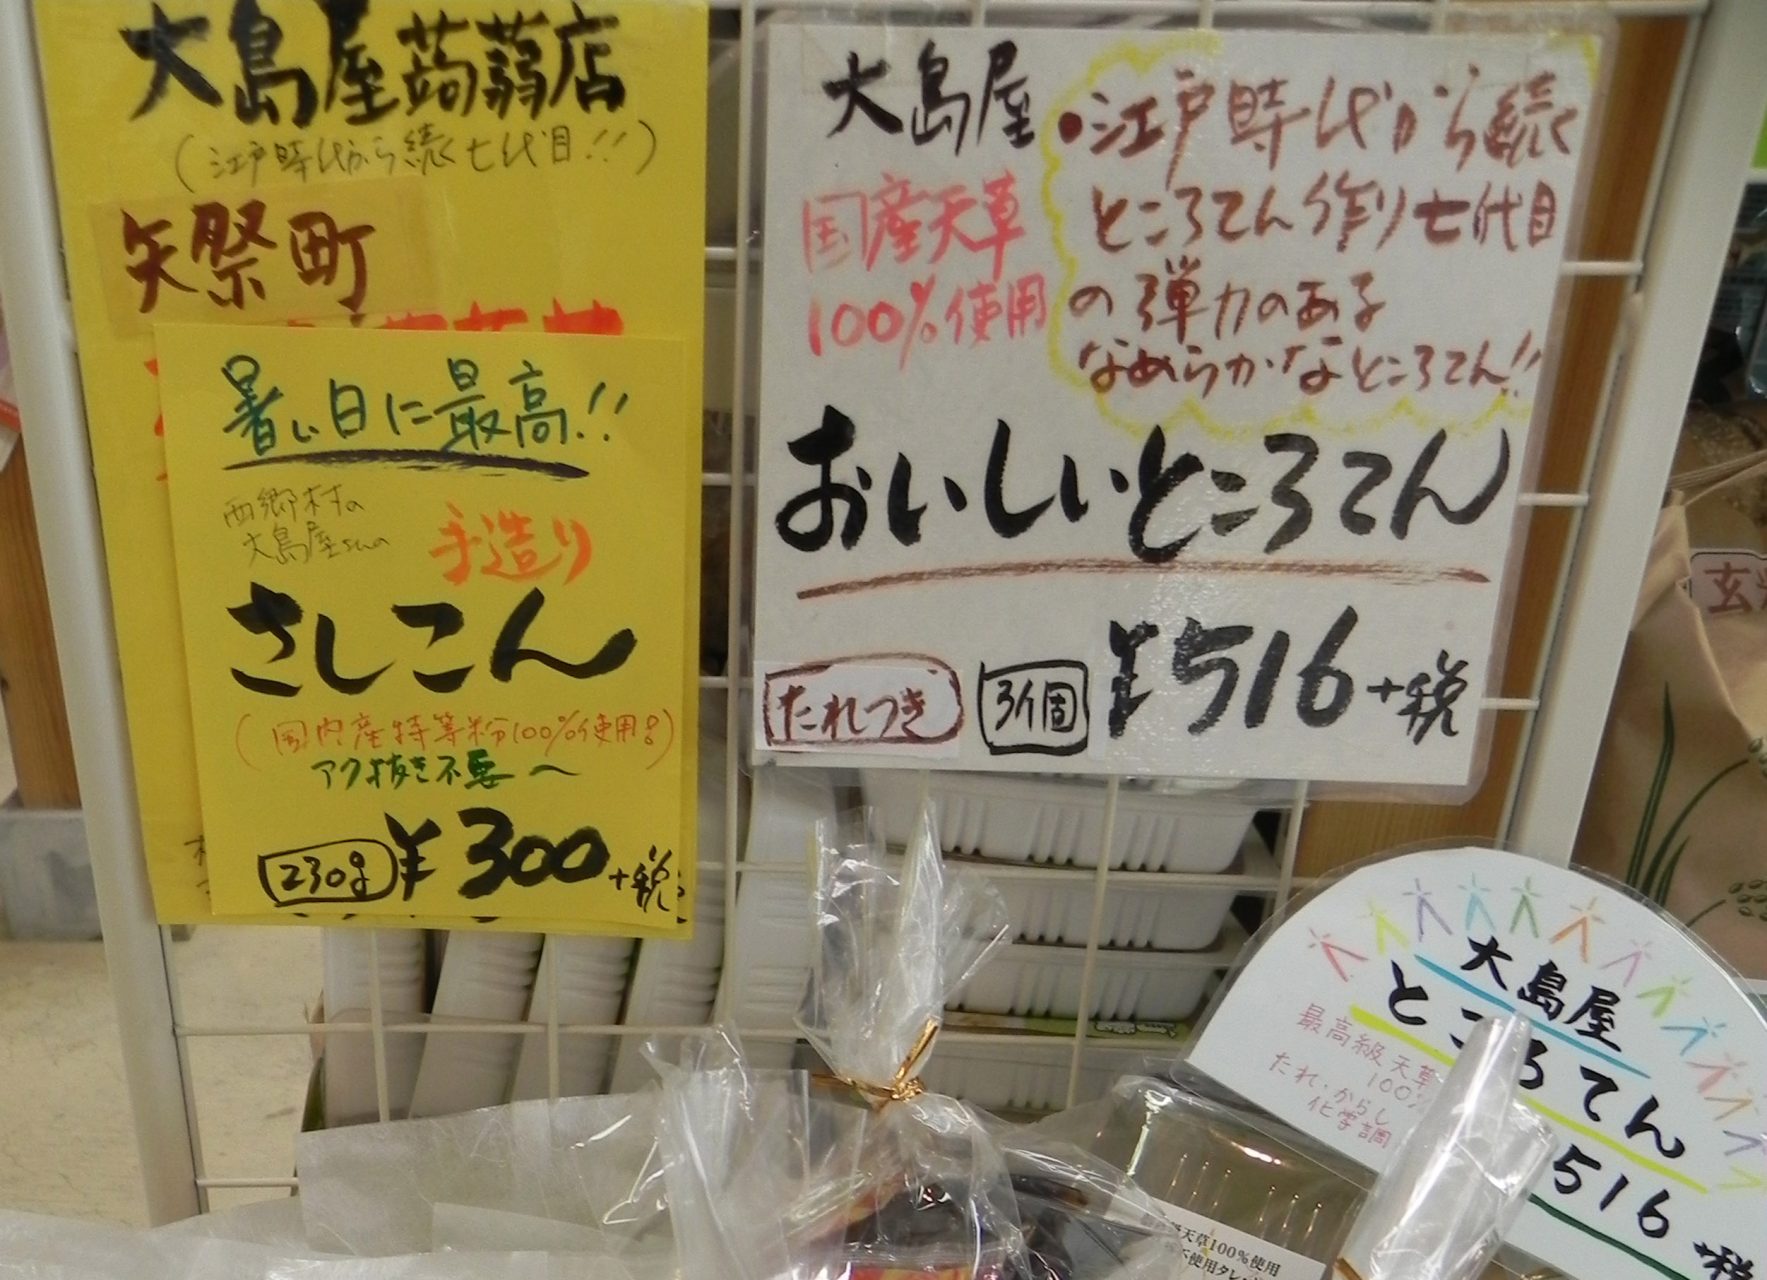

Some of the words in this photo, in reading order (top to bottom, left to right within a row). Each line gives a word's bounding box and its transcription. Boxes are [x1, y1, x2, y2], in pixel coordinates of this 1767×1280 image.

[122, 0, 626, 125] 大島屋蒟蒻店
[822, 41, 1035, 156] 大島屋
[122, 199, 375, 313] 矢祭町
[802, 171, 1024, 282] 国産天草
[1092, 169, 1558, 253] ところてん作り七代目
[808, 275, 1048, 371] 100%使用
[1068, 256, 1387, 344] の弾力のある
[775, 405, 1509, 564] おいしいところてん
[429, 503, 593, 585] 手造り
[226, 581, 638, 698] さしこん
[776, 684, 928, 742] たれつき
[1297, 1003, 1437, 1090] 最高級天草
[1461, 935, 1622, 1053] 大島屋
